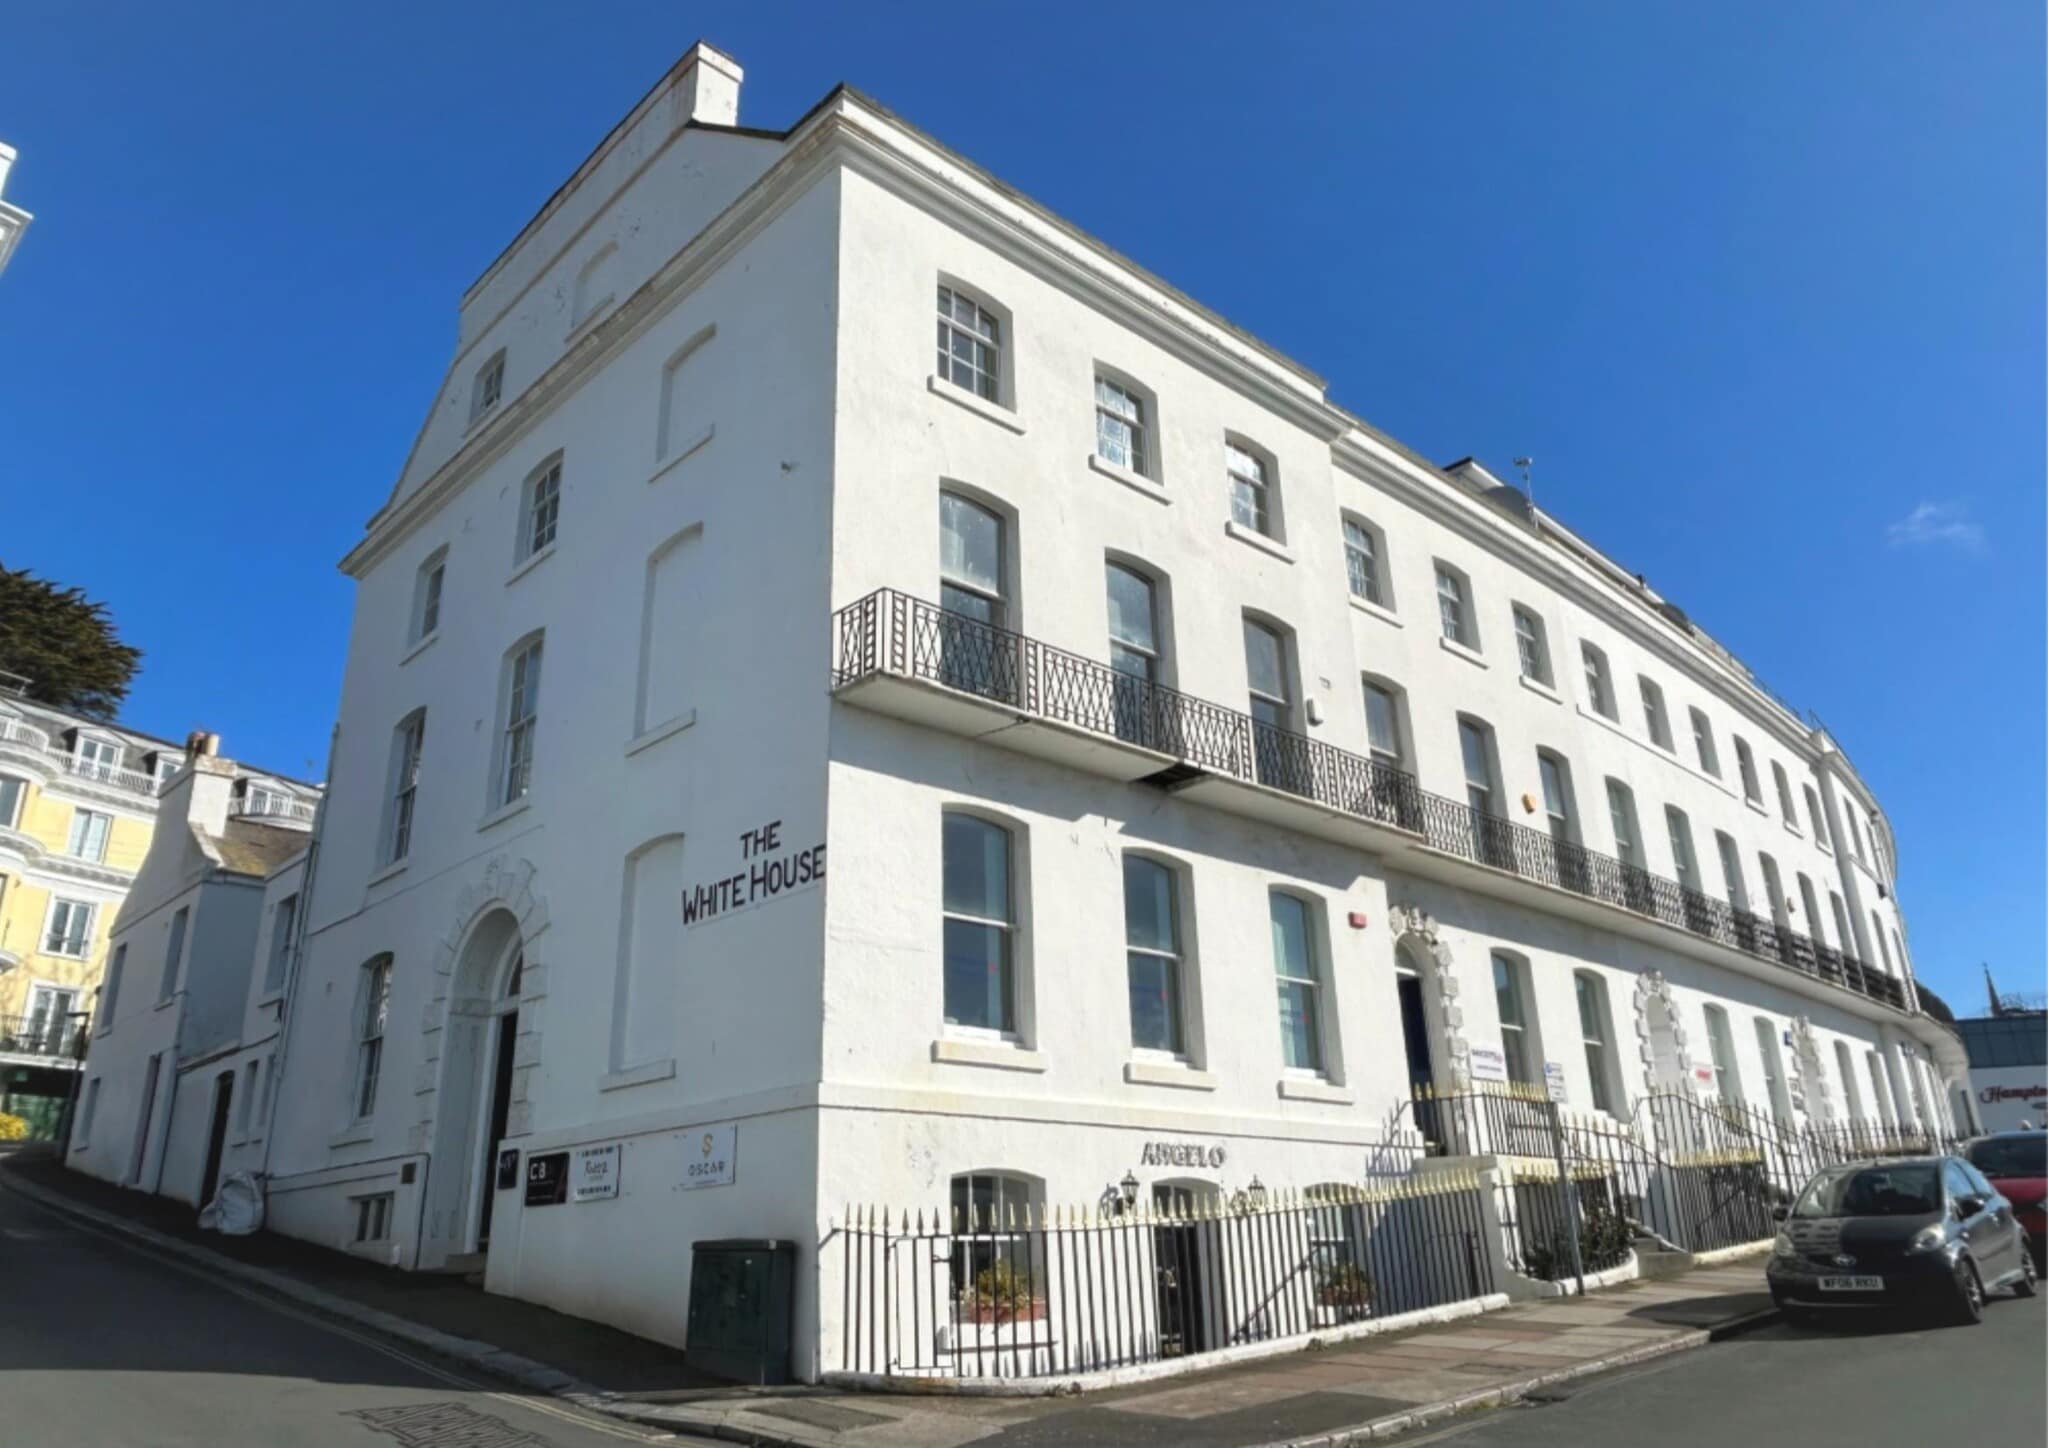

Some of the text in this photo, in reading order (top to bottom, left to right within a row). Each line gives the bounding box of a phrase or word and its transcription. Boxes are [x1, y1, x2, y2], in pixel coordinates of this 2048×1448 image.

[740, 820, 782, 859] THE
[682, 844, 827, 925] WHITE HOUSE
[687, 1160, 726, 1177] OSCAR
[1141, 1142, 1226, 1168] ANGELO
